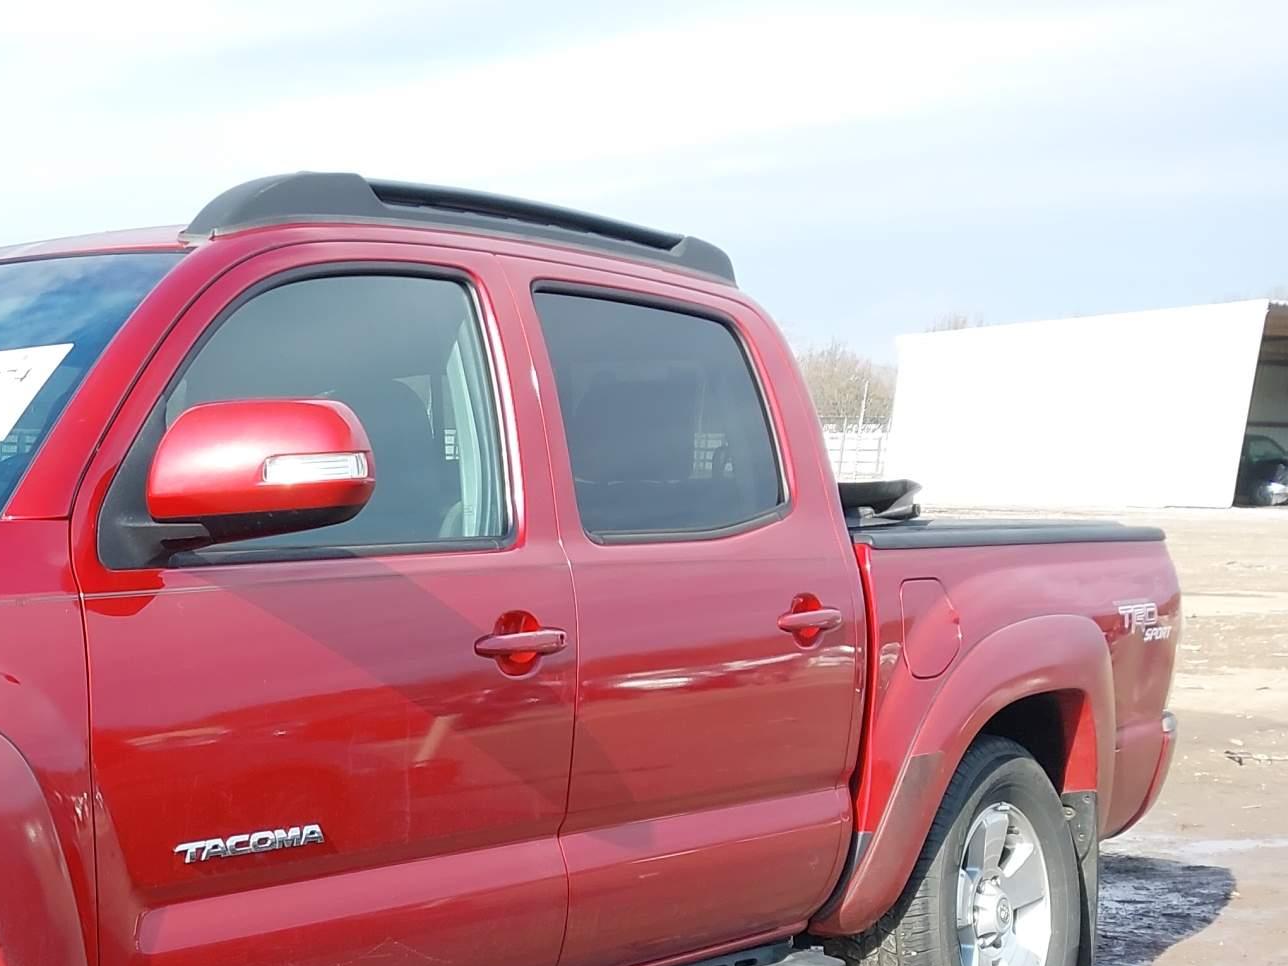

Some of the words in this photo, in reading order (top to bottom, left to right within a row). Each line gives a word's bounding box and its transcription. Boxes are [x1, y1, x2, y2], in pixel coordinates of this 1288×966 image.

[1118, 603, 1158, 635] TRD
[1143, 626, 1172, 642] SPORT
[174, 823, 325, 864] TACOMA
